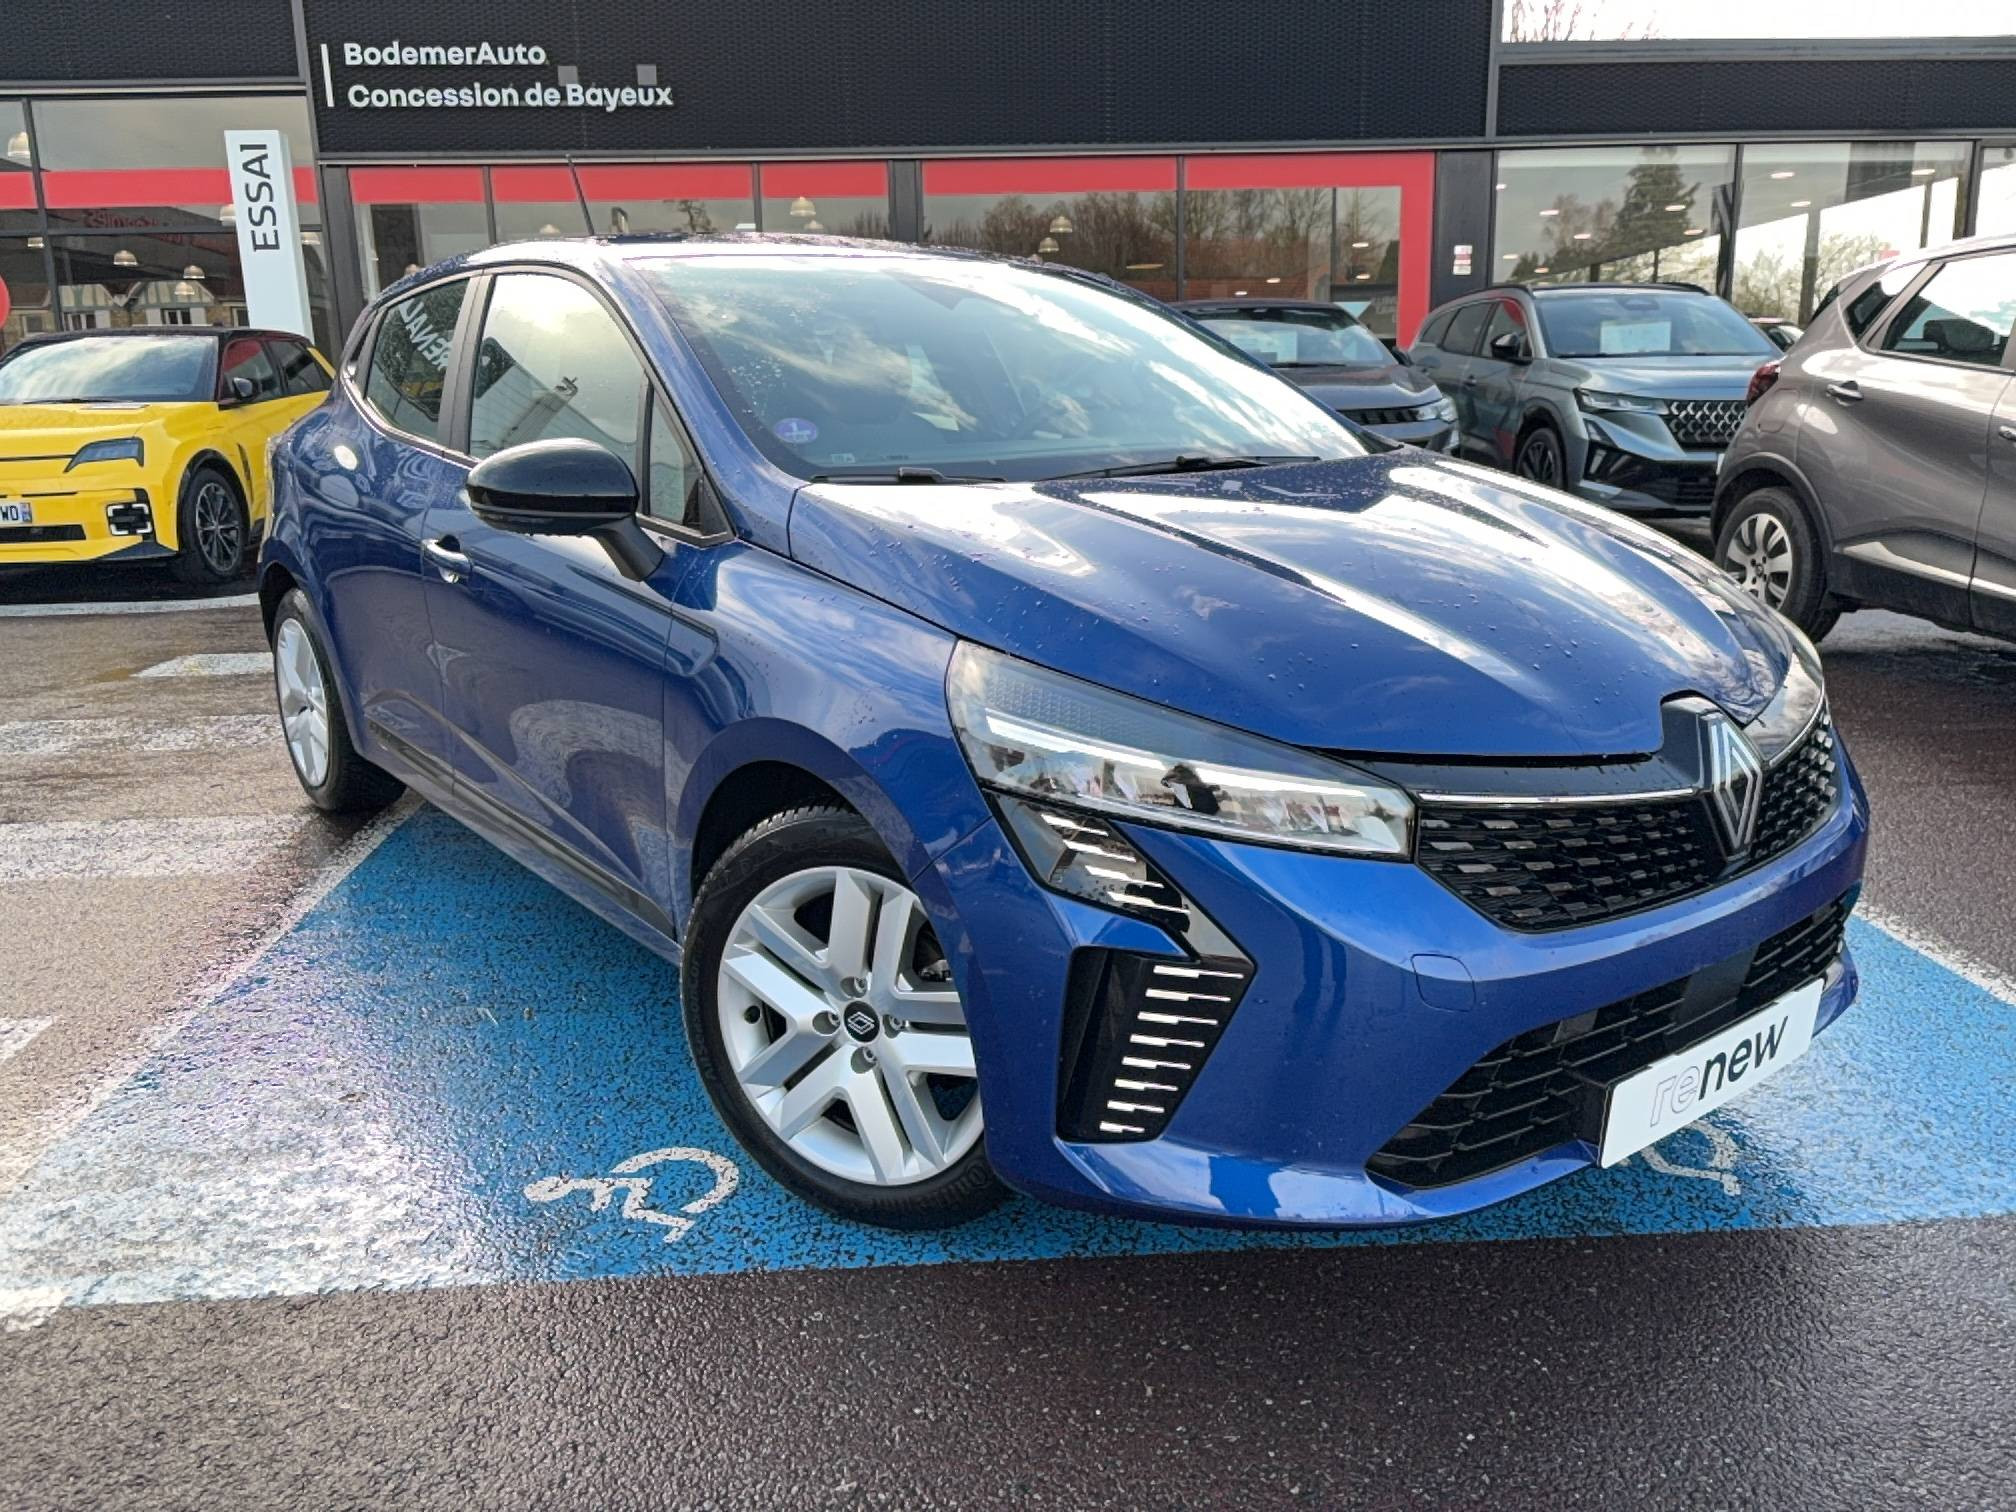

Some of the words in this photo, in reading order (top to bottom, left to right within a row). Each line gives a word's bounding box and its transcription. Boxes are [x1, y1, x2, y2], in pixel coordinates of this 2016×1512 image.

[343, 41, 547, 66] BodemerAuto
[347, 82, 520, 108] Concession
[524, 82, 561, 107] de
[566, 83, 673, 112] Bayeux
[240, 144, 280, 252] ESSAI
[1650, 1015, 1788, 1128] renew
